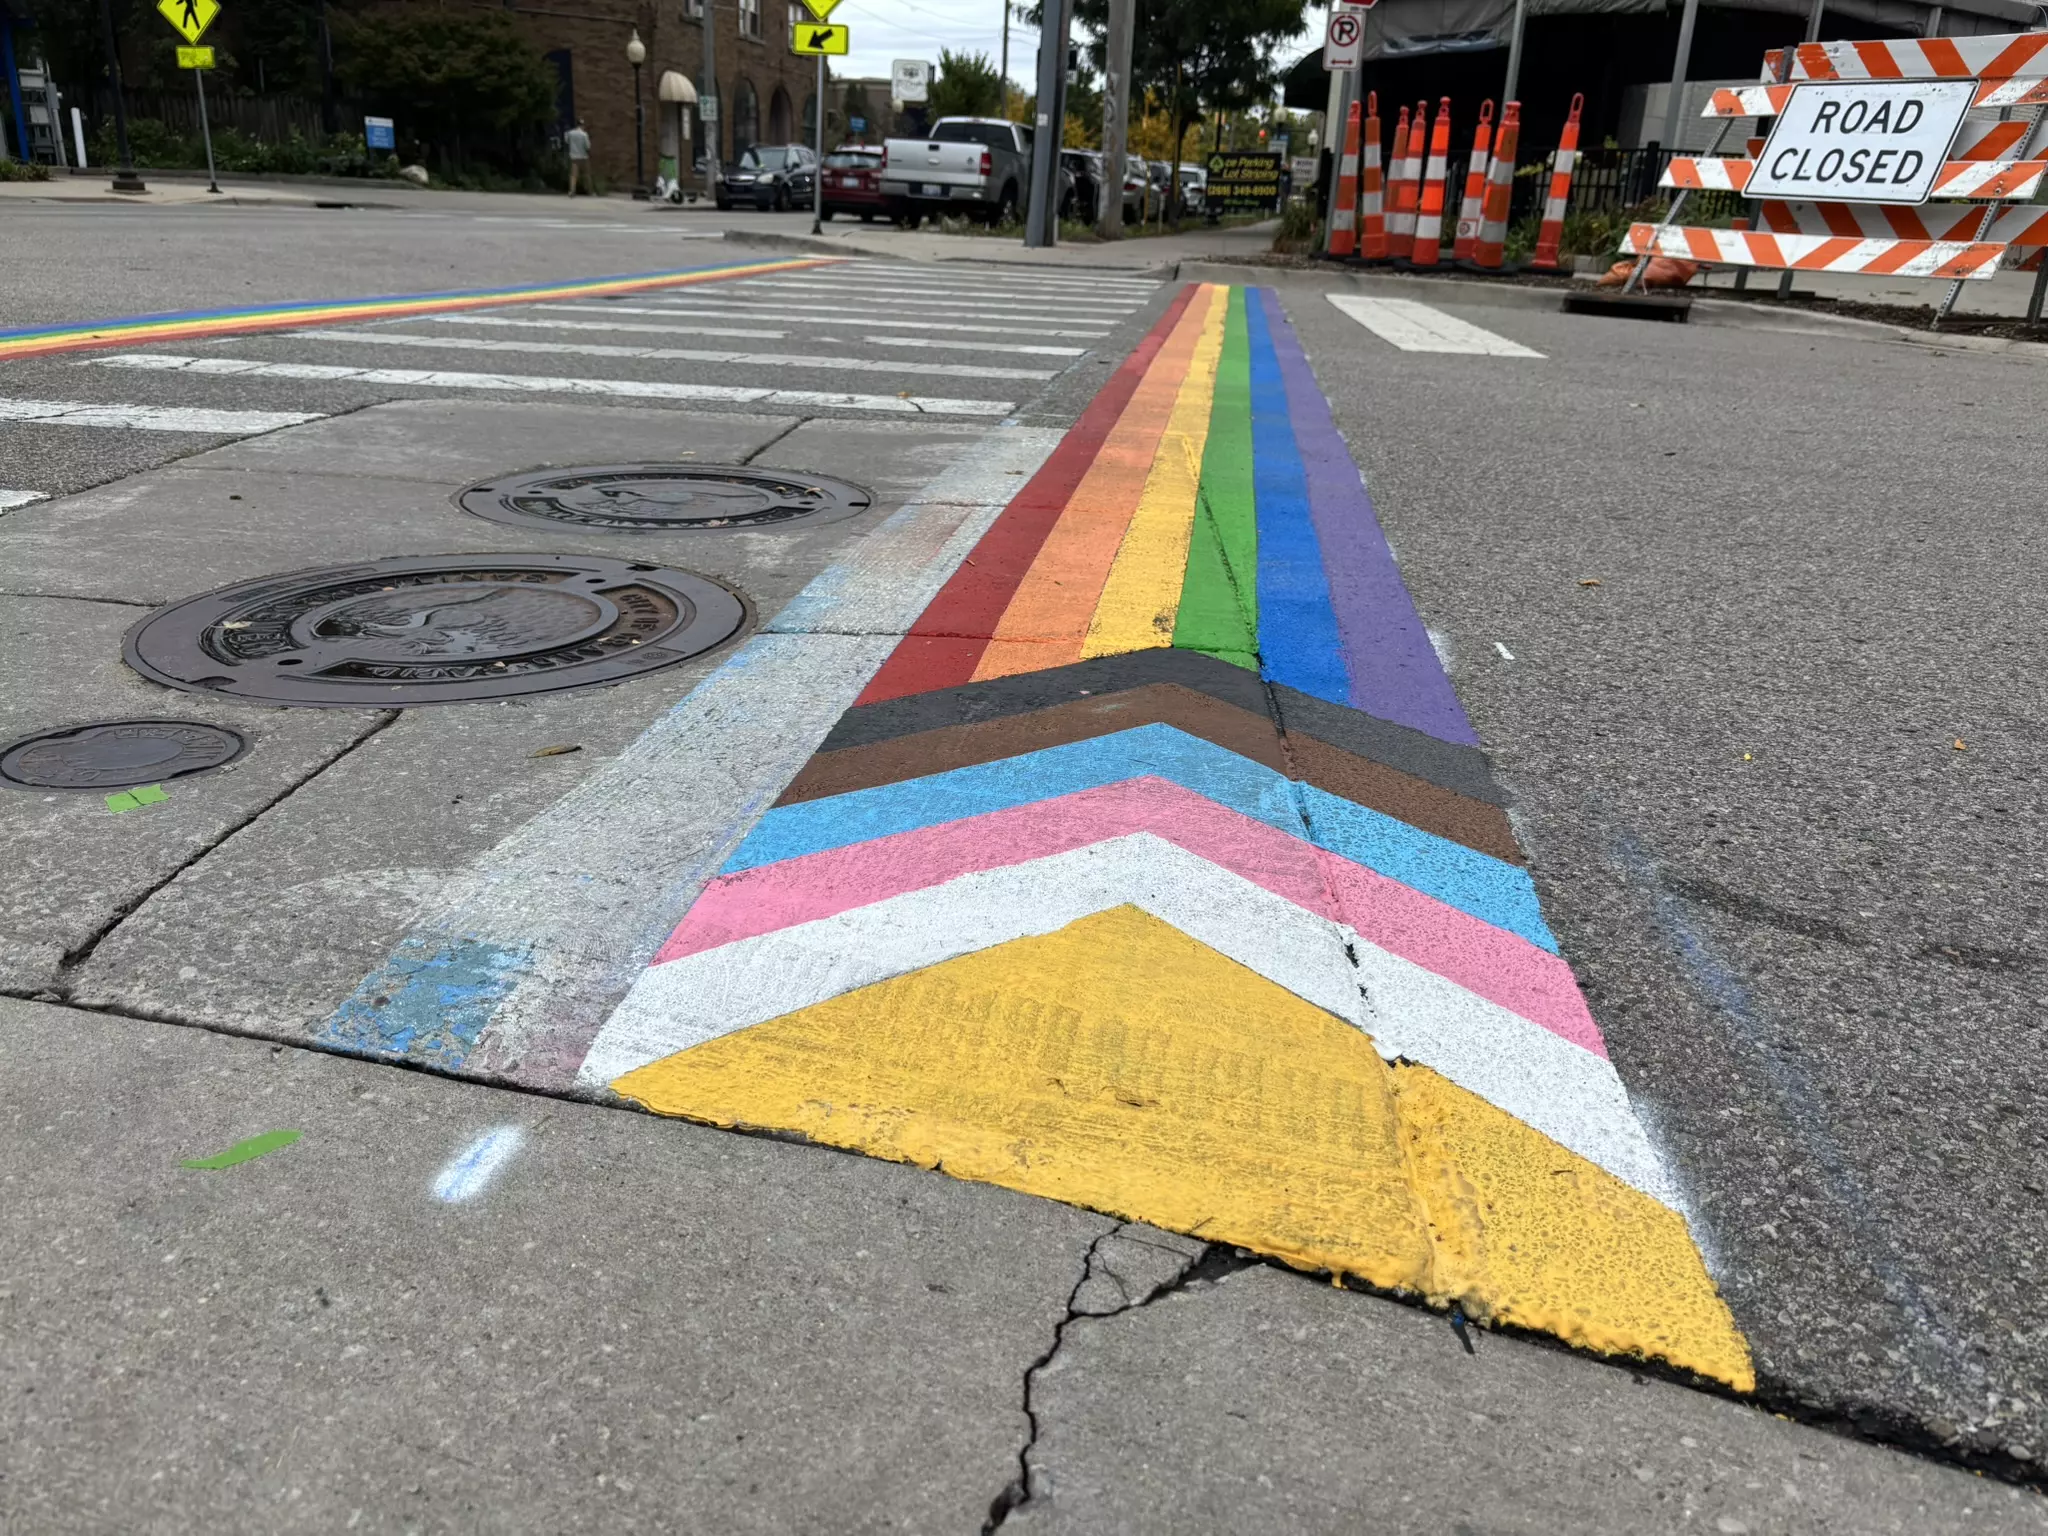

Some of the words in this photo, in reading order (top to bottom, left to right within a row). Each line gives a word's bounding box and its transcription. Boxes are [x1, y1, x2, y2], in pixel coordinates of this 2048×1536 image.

[1811, 99, 1924, 134] ROAD
[1238, 157, 1275, 169] Parking
[1770, 147, 1923, 184] CLOSED
[1223, 169, 1240, 178] Lot
[1241, 168, 1279, 181] Striping
[619, 594, 659, 613] CITY
